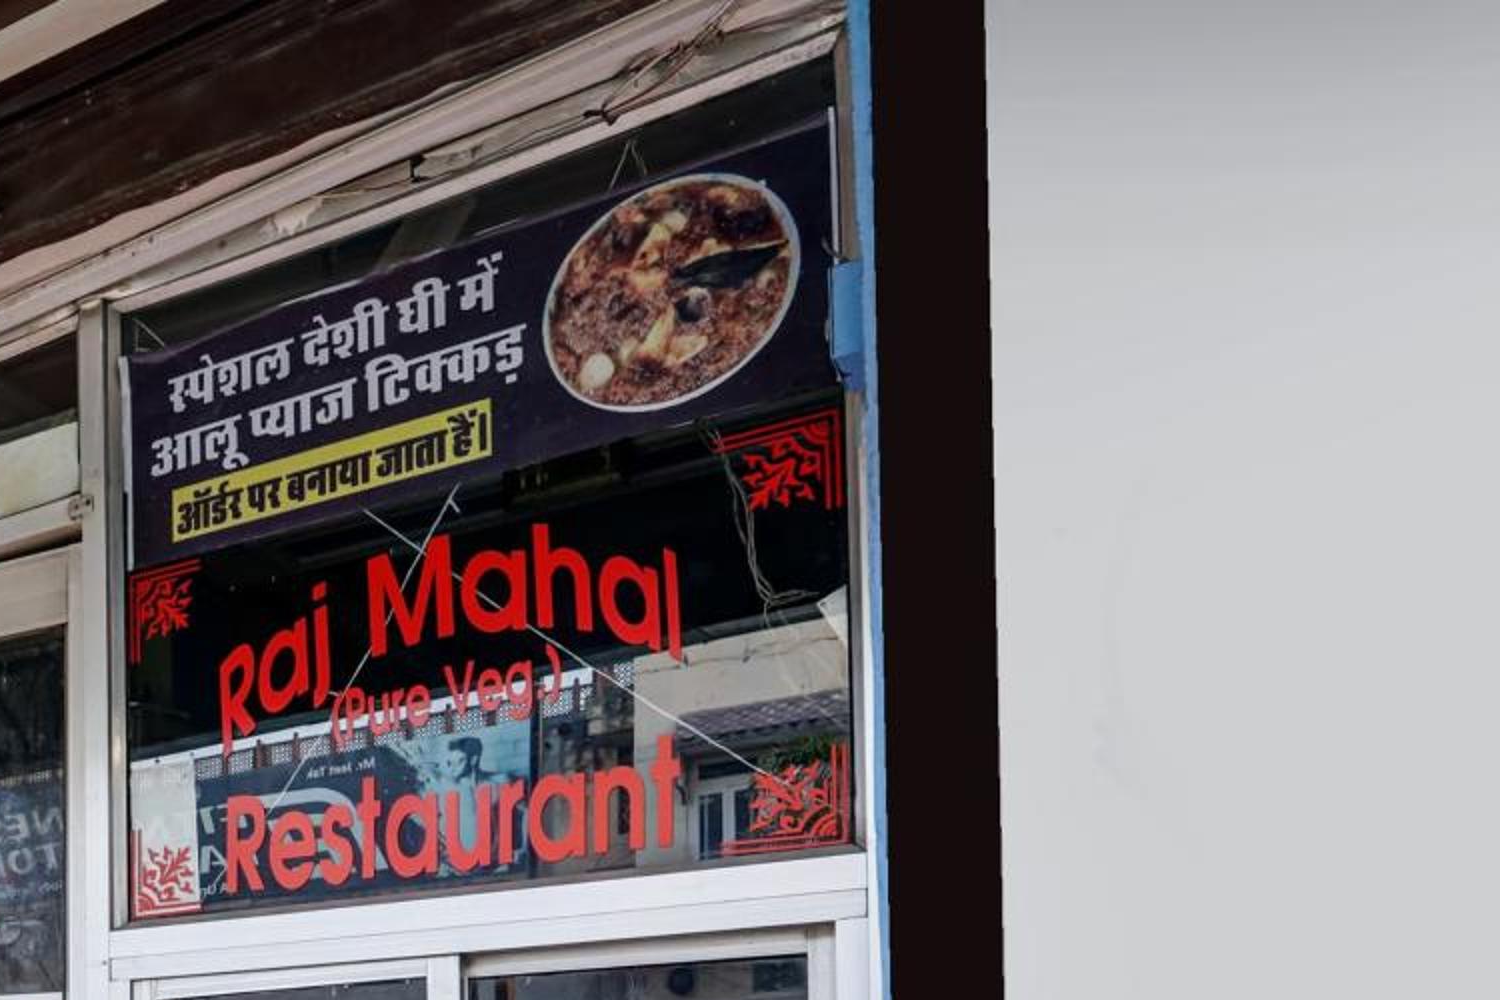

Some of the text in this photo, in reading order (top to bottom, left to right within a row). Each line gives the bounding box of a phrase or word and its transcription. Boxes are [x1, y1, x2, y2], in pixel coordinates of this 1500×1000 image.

[168, 251, 502, 413] स्पेशल देशी घी में
[151, 413, 249, 477] आलू
[250, 376, 357, 438] प्याज
[246, 477, 285, 513] पर
[286, 451, 372, 501] बनाया
[375, 430, 449, 478] जाता
[219, 524, 683, 758] Raj Mahal
[330, 643, 562, 753] (Pure Veg.)
[225, 734, 682, 894] Restaurant
